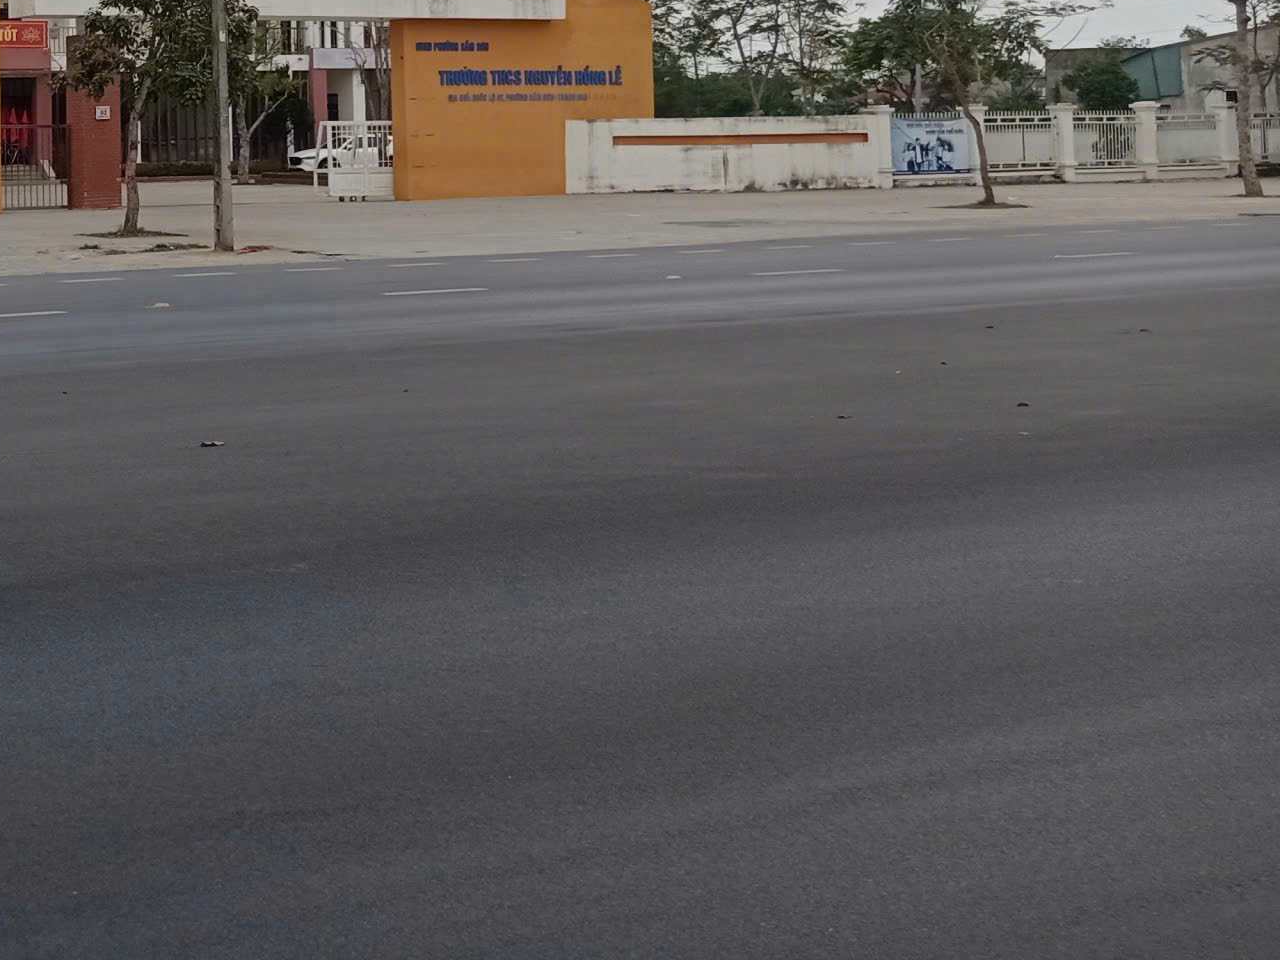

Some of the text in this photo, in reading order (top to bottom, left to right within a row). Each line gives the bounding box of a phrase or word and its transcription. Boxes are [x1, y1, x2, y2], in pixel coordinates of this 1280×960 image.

[438, 66, 488, 86] TRƯỜNG
[490, 69, 522, 86] THCS
[524, 65, 573, 86] NGUYỄN
